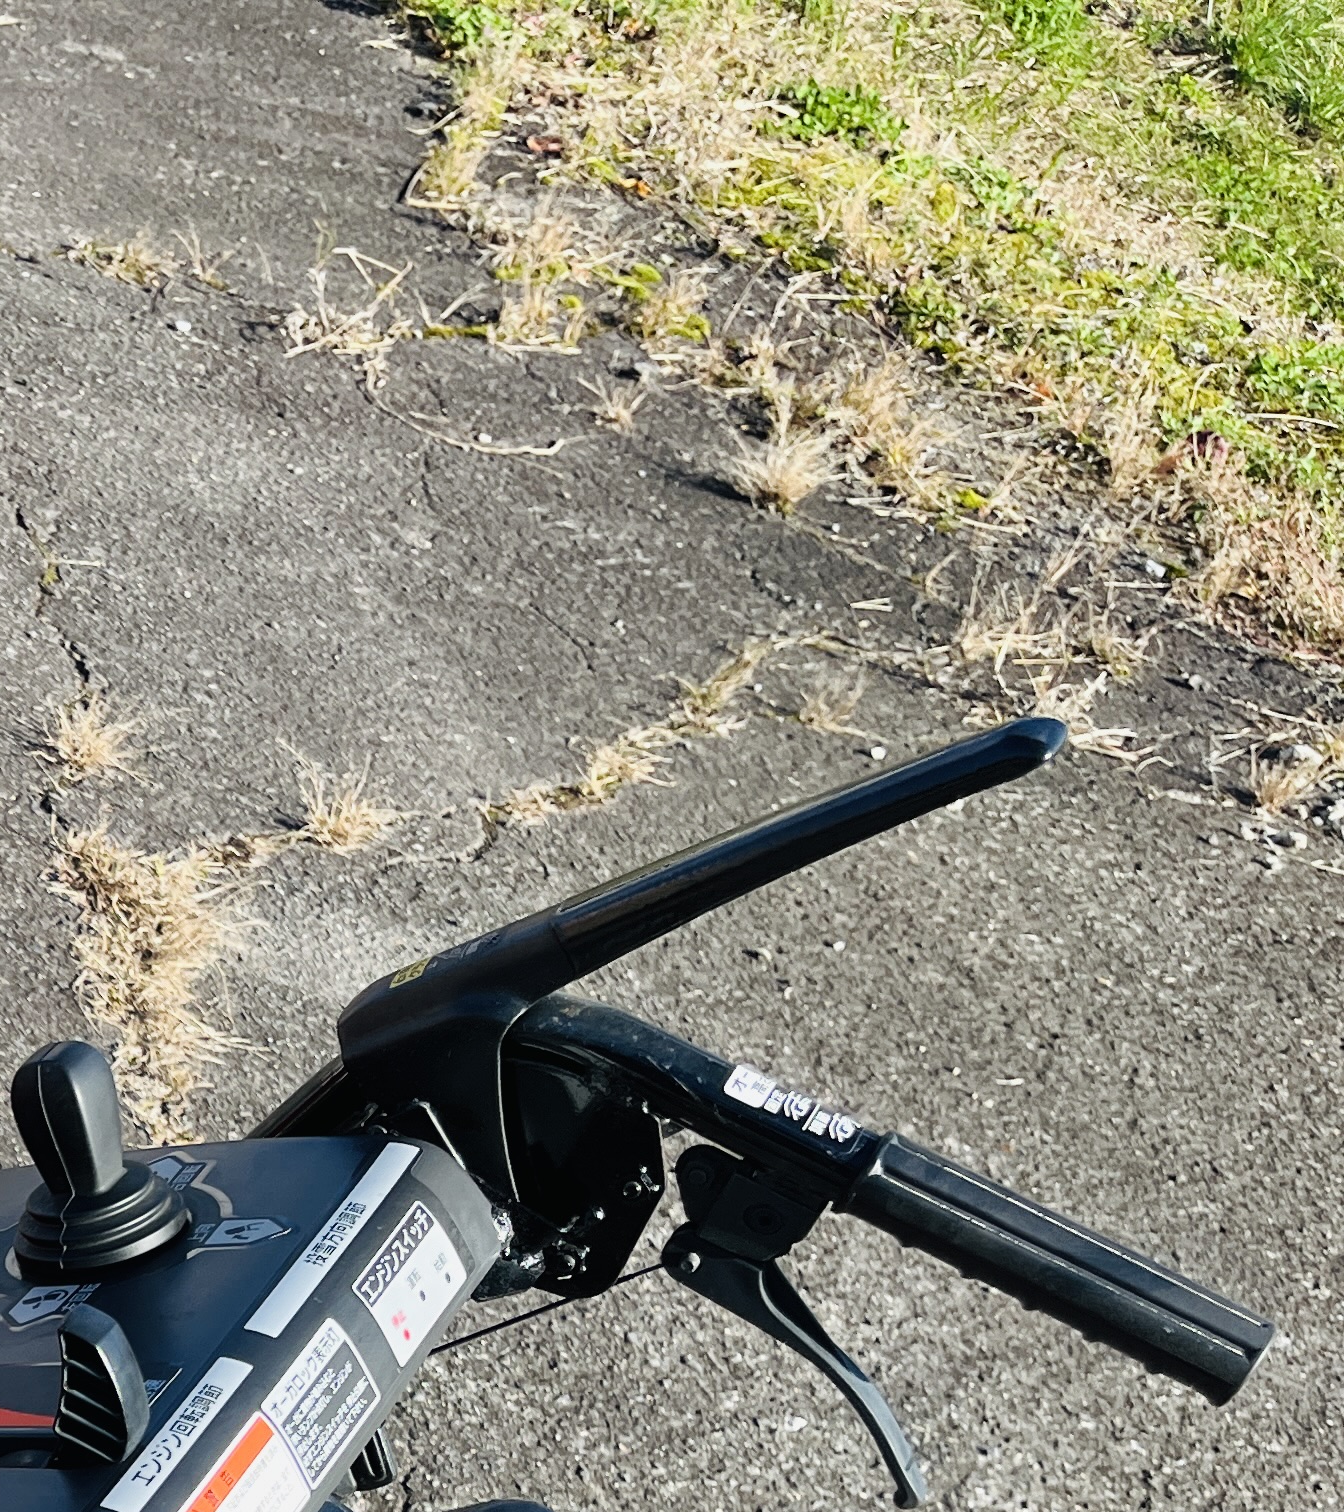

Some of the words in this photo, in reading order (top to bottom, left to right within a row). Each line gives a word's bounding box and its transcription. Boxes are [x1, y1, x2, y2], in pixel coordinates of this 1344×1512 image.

[305, 1201, 367, 1267] 投雪方向調節
[361, 1208, 429, 1304] エンジンスイッチ
[270, 1326, 340, 1419] オーガロック表示灯
[129, 1380, 223, 1487] エンジン回転調節
